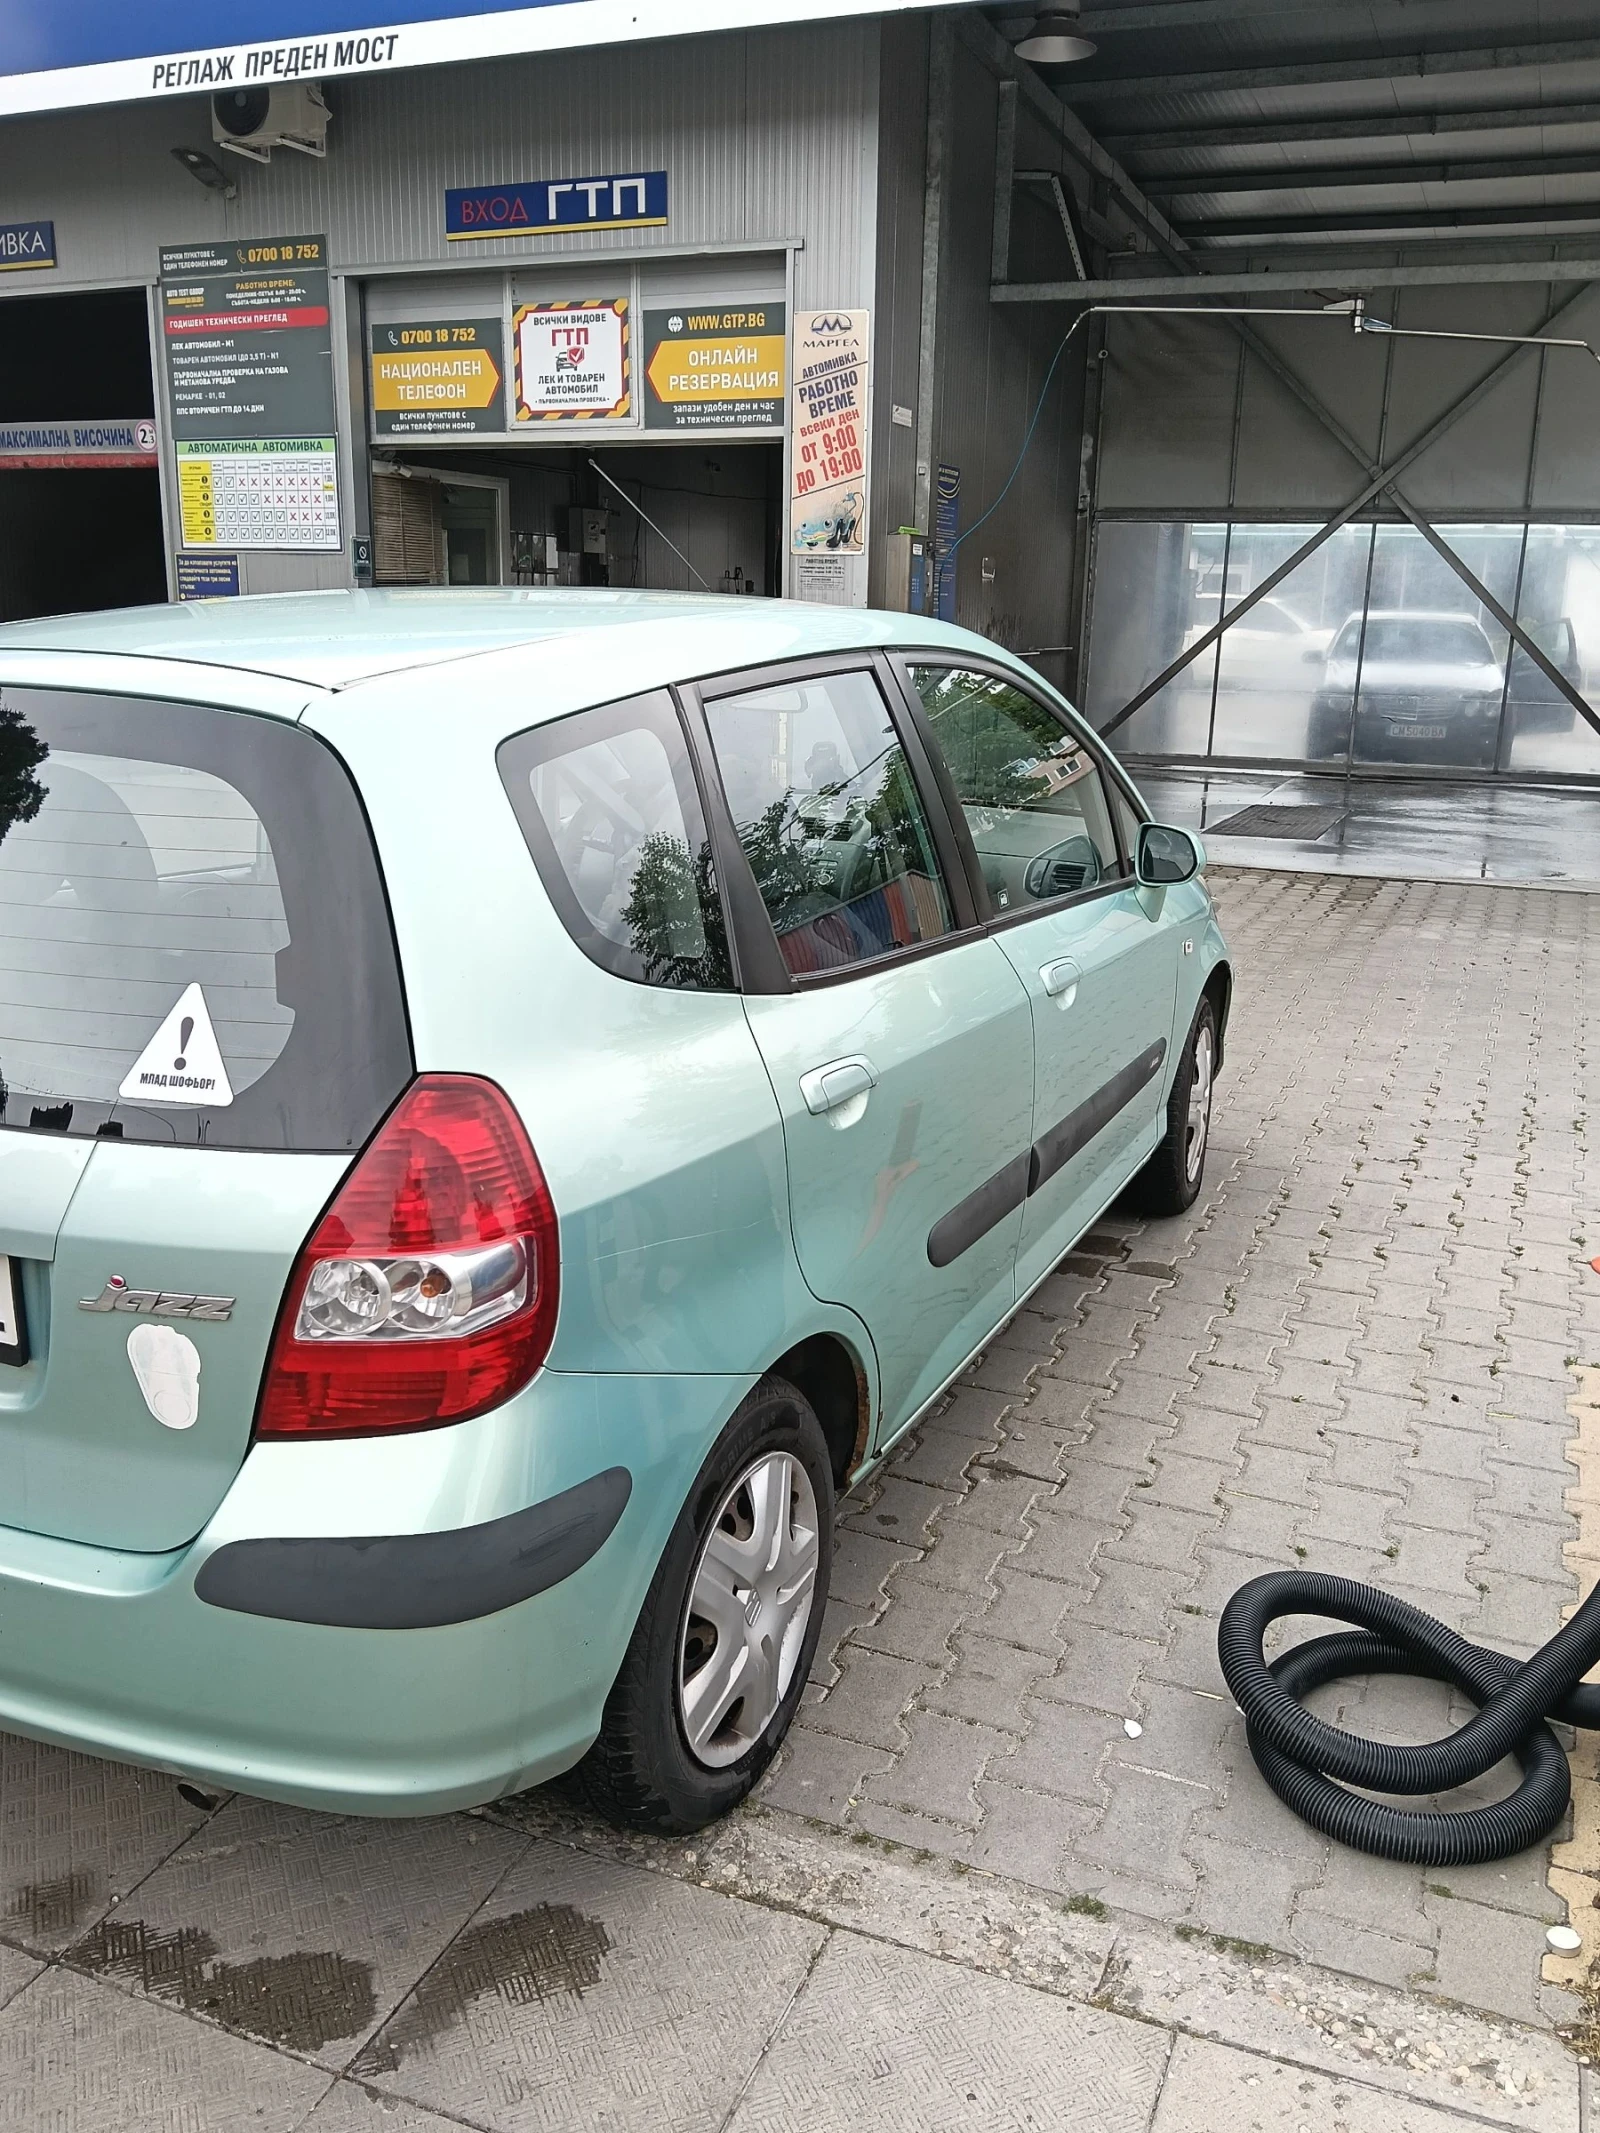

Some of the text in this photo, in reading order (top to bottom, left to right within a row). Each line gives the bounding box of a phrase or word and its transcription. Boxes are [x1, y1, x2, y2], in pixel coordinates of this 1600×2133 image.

[152, 34, 399, 89] РЕГЛАЖ ПРЕДЕН МОСТ
[462, 178, 645, 224] ВХОД ГТП
[248, 244, 319, 262] 0700 18 752
[210, 259, 228, 267] НОМЕР
[235, 281, 268, 290] РАБОТНО
[169, 313, 288, 329] ГОДИШЕН ТЕХНИЧЕСКИ ПРЕГЛЕД
[533, 313, 607, 326] ВСИЧКИ ВИДОВЕ
[687, 312, 765, 331] WWW.GTP.BG
[401, 327, 476, 344] 0700 18 752
[551, 327, 589, 346] ГТП
[802, 338, 860, 348] МАРГЕЛ
[184, 340, 221, 350] АВТОМОБИЛ
[172, 357, 200, 365] ТОВАРЕН
[200, 354, 237, 363] АВТОМОБИЛ
[688, 345, 758, 366] ОНЛАЙН
[173, 366, 289, 379] ПЪРВОНАЧАЛНА ПРОВЕРКА НА ГАЗОВА
[381, 360, 482, 381] НАЦИОНАЛЕН
[802, 351, 858, 379] АВТОМИВКА
[180, 378, 211, 386] МЕТАНОВА
[211, 376, 236, 385] УРЕДБА
[538, 373, 605, 385] ЛЕК И ТОВАРЕН
[669, 371, 779, 391] РЕЗЕРВАЦИЯ
[798, 370, 859, 404] РАБОТНО
[175, 393, 203, 401] РЕМАРКЕ
[397, 383, 466, 400] ТЕЛЕФОН
[545, 384, 598, 395] АВТОМОБИЛ
[189, 406, 220, 414] ВТОРИЧЕН
[220, 405, 232, 413] ГТП
[233, 405, 242, 414] ДО
[251, 404, 264, 412] ДНИ
[673, 401, 775, 414] запази удобен ден и час
[808, 390, 856, 419] ВРЕМЕ
[399, 411, 467, 421] всички пунктове с
[687, 414, 735, 424] технически
[737, 413, 772, 424] преглед
[800, 408, 860, 437] всеки ден
[391, 421, 476, 432] един телефонен номер
[0, 428, 134, 449] МАКСИМАЛНА ВИСОЧИНА
[822, 424, 857, 455] 9:00
[188, 441, 323, 453] АВТОМАТИЧНА АВТОМИВКА
[819, 448, 862, 481] 19:00
[140, 1073, 216, 1090] МЛАД ШОФЬОР!
